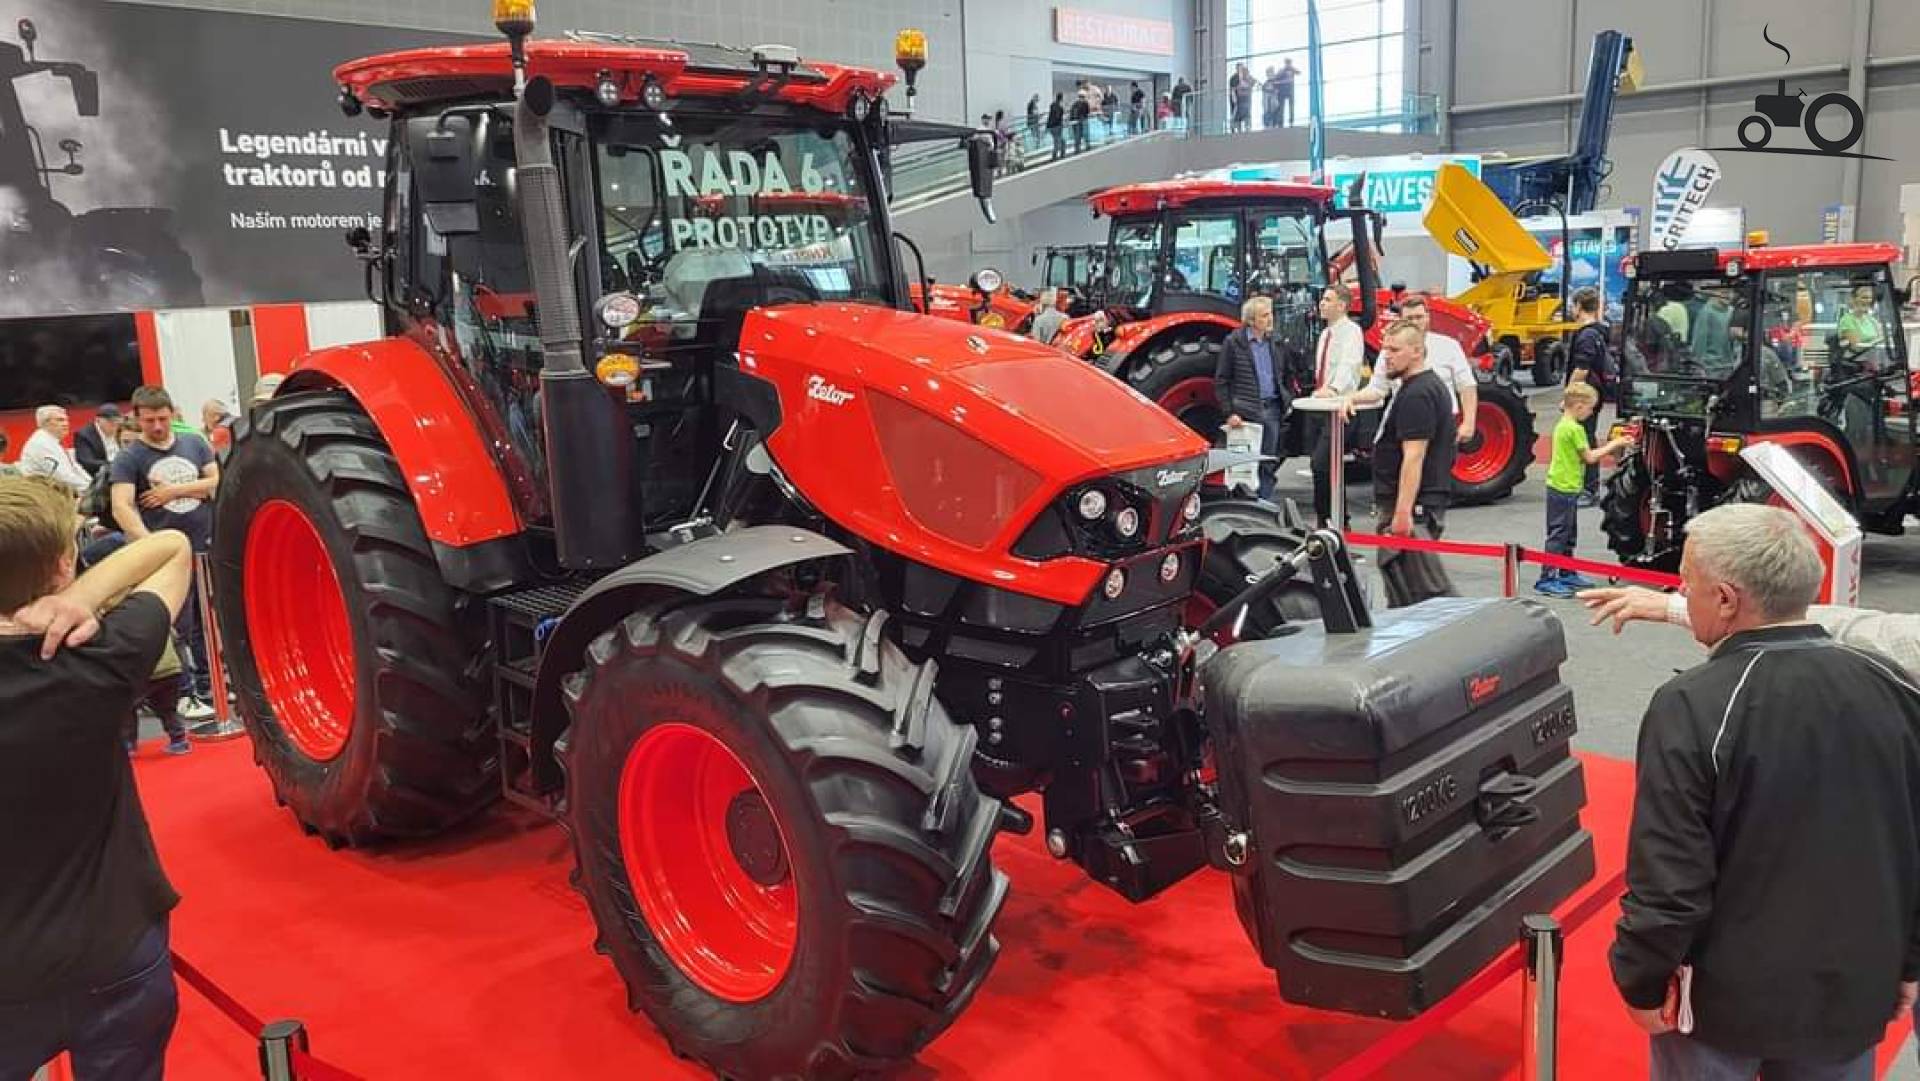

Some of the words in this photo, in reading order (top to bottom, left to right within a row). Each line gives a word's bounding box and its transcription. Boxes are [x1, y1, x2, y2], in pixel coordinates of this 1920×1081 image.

[219, 127, 367, 160] Legendární
[223, 160, 336, 187] traktorů
[342, 165, 371, 187] od
[659, 134, 793, 197] ŘADA
[801, 153, 824, 194] 6
[230, 210, 287, 229] Naším
[291, 212, 363, 229] motorem
[671, 214, 830, 251] PROTOTYP
